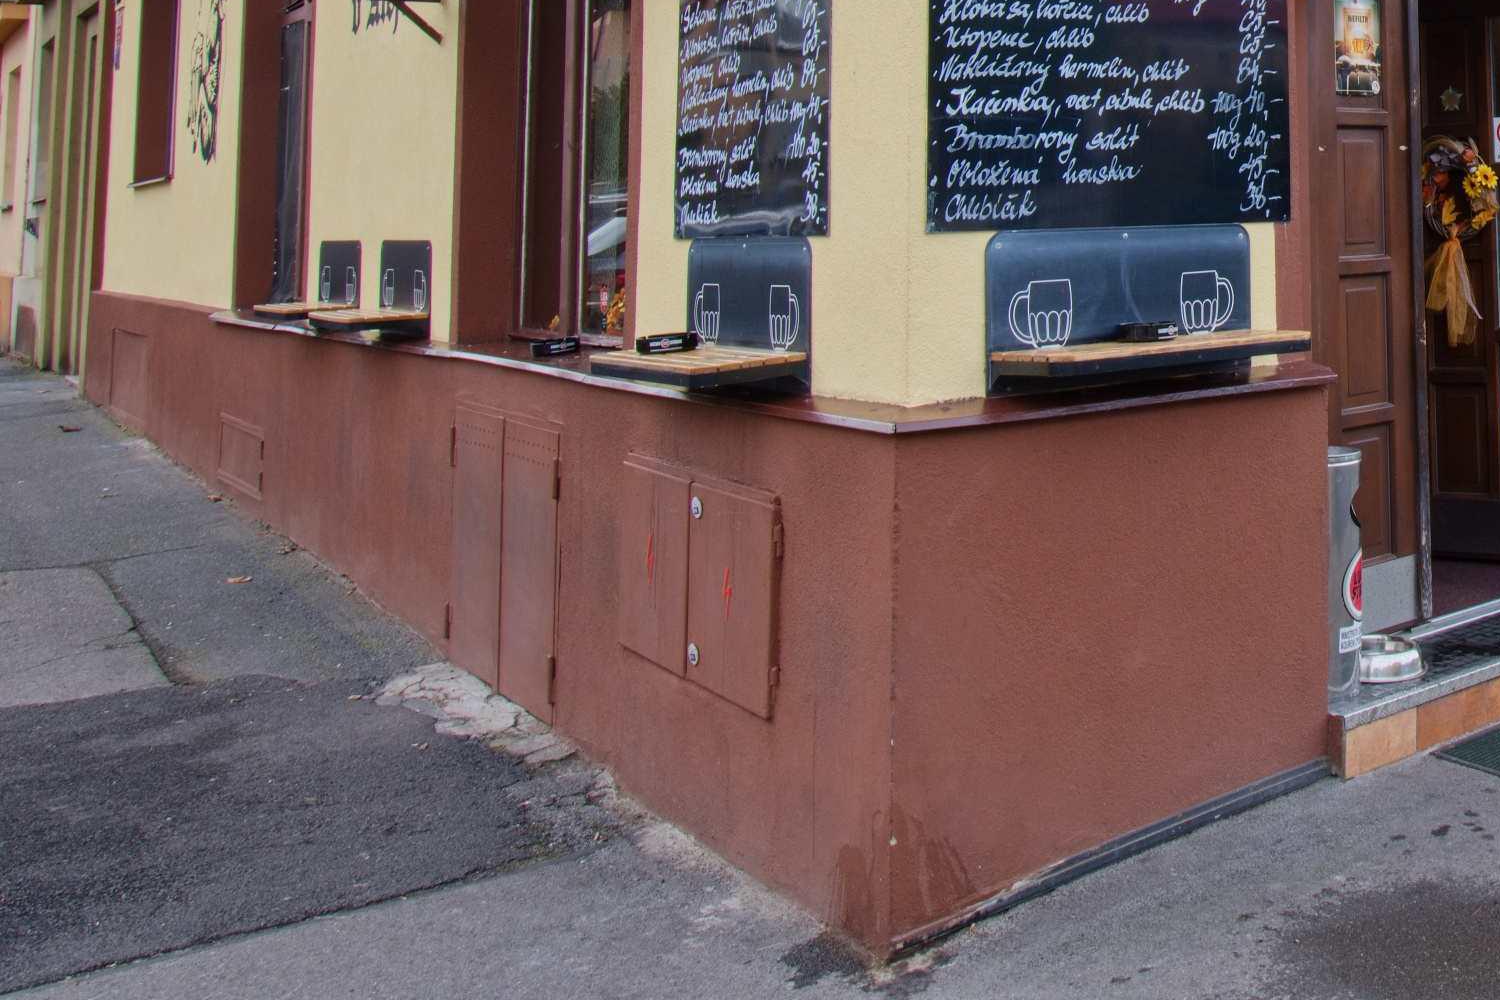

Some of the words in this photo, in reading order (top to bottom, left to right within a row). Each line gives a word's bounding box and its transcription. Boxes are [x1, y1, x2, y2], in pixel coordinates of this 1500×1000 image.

[944, 118, 1082, 164] Bramborový
[1085, 122, 1140, 151] salát
[947, 155, 1041, 188] Obložená
